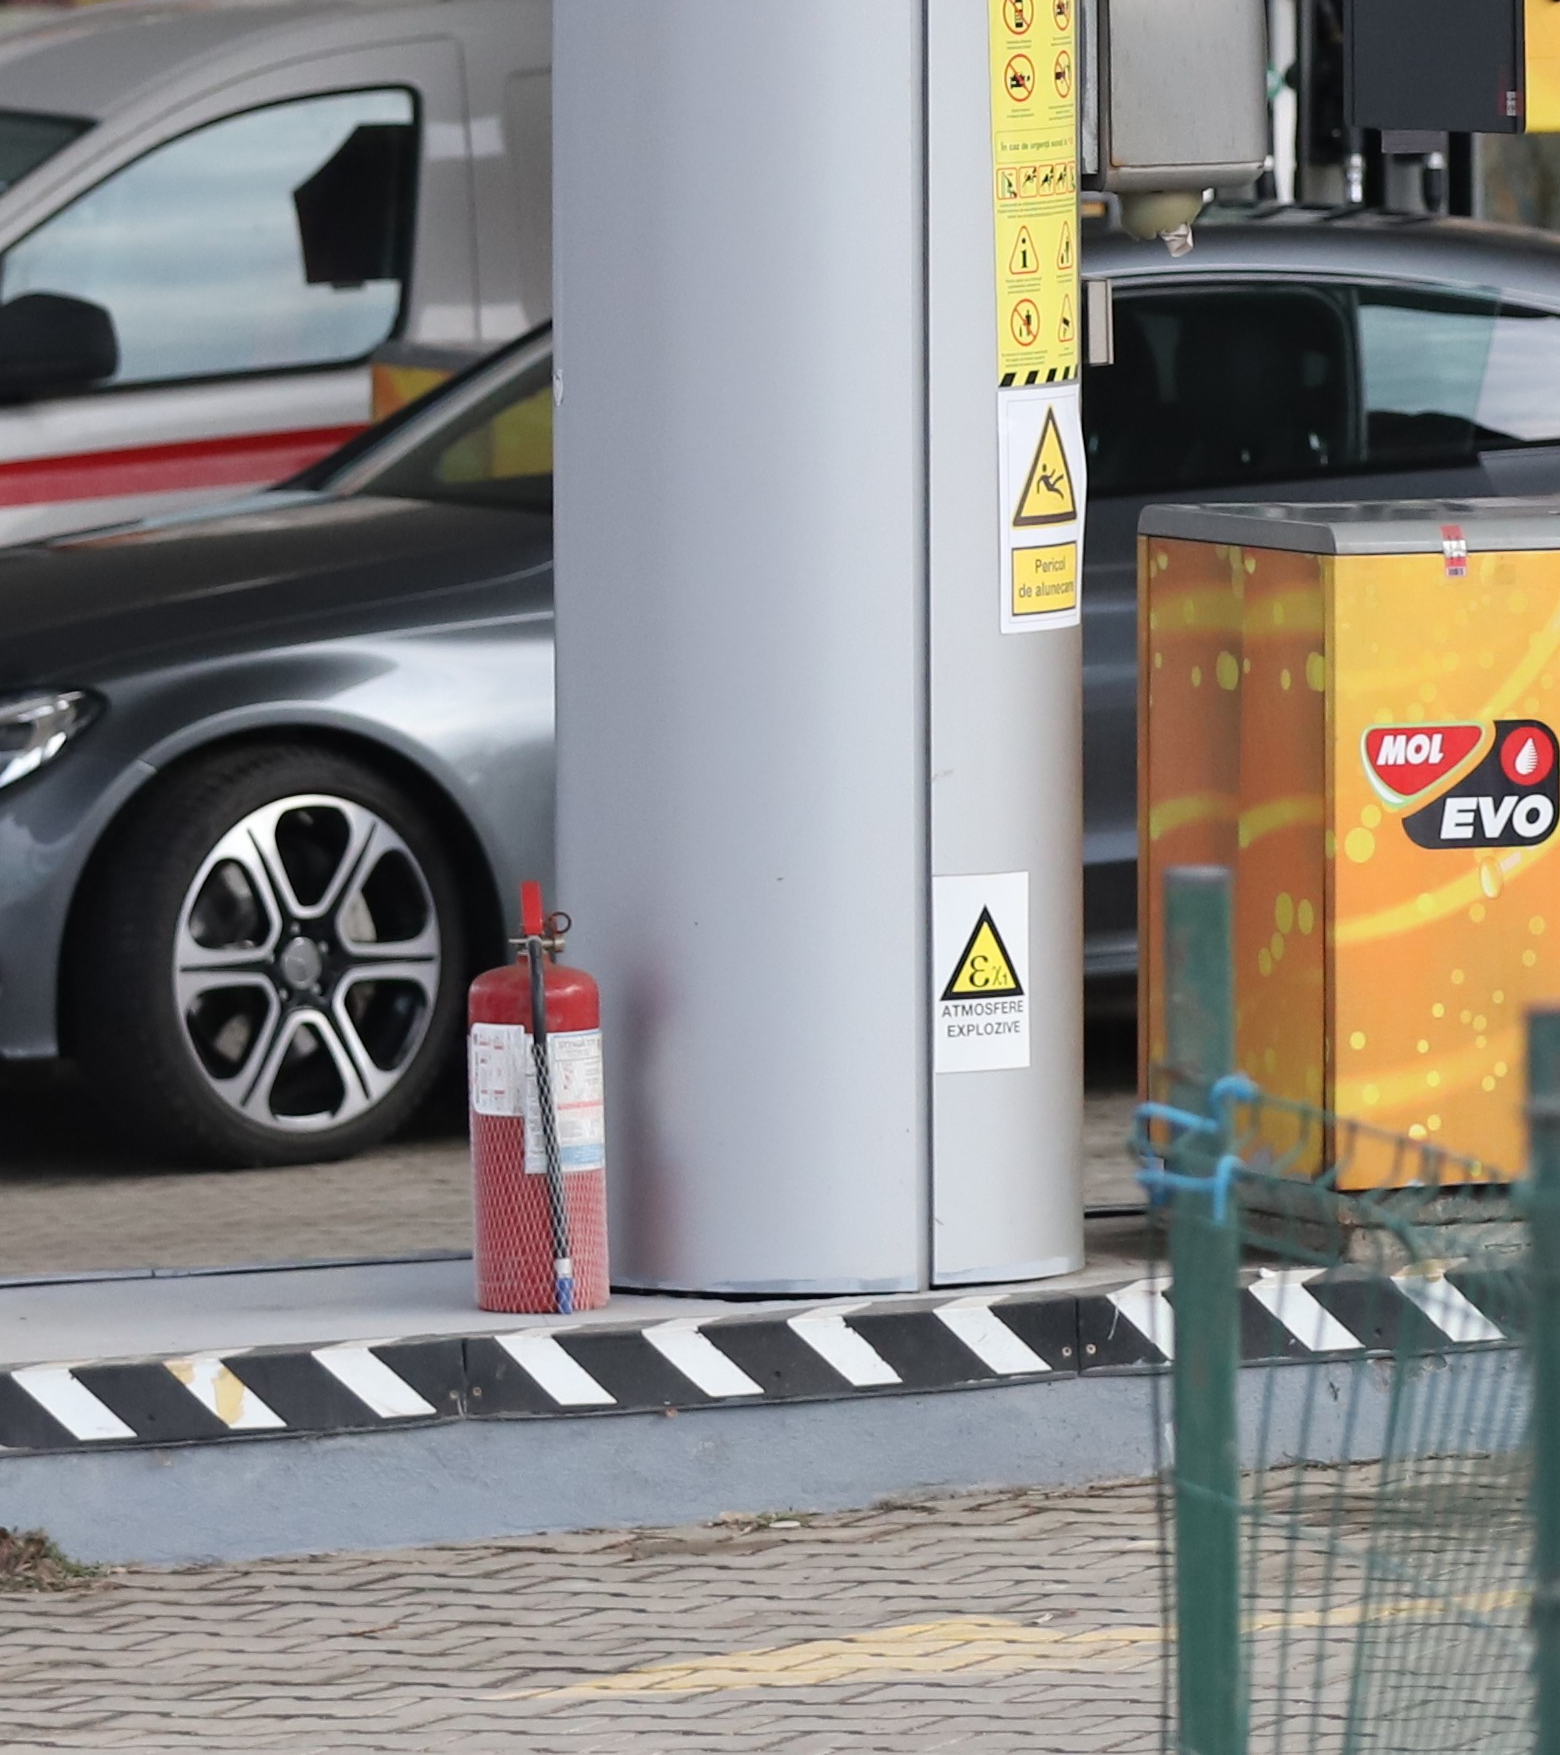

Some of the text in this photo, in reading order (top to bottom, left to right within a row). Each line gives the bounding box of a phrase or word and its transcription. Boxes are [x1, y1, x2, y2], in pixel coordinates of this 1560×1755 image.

[1034, 556, 1066, 574] Pericol
[1018, 582, 1033, 598] de
[1375, 733, 1444, 766] MOL
[1439, 794, 1555, 840] EVO
[941, 999, 1025, 1018] ATMOSFERE
[946, 1020, 1021, 1038] EXPLOZIVE
